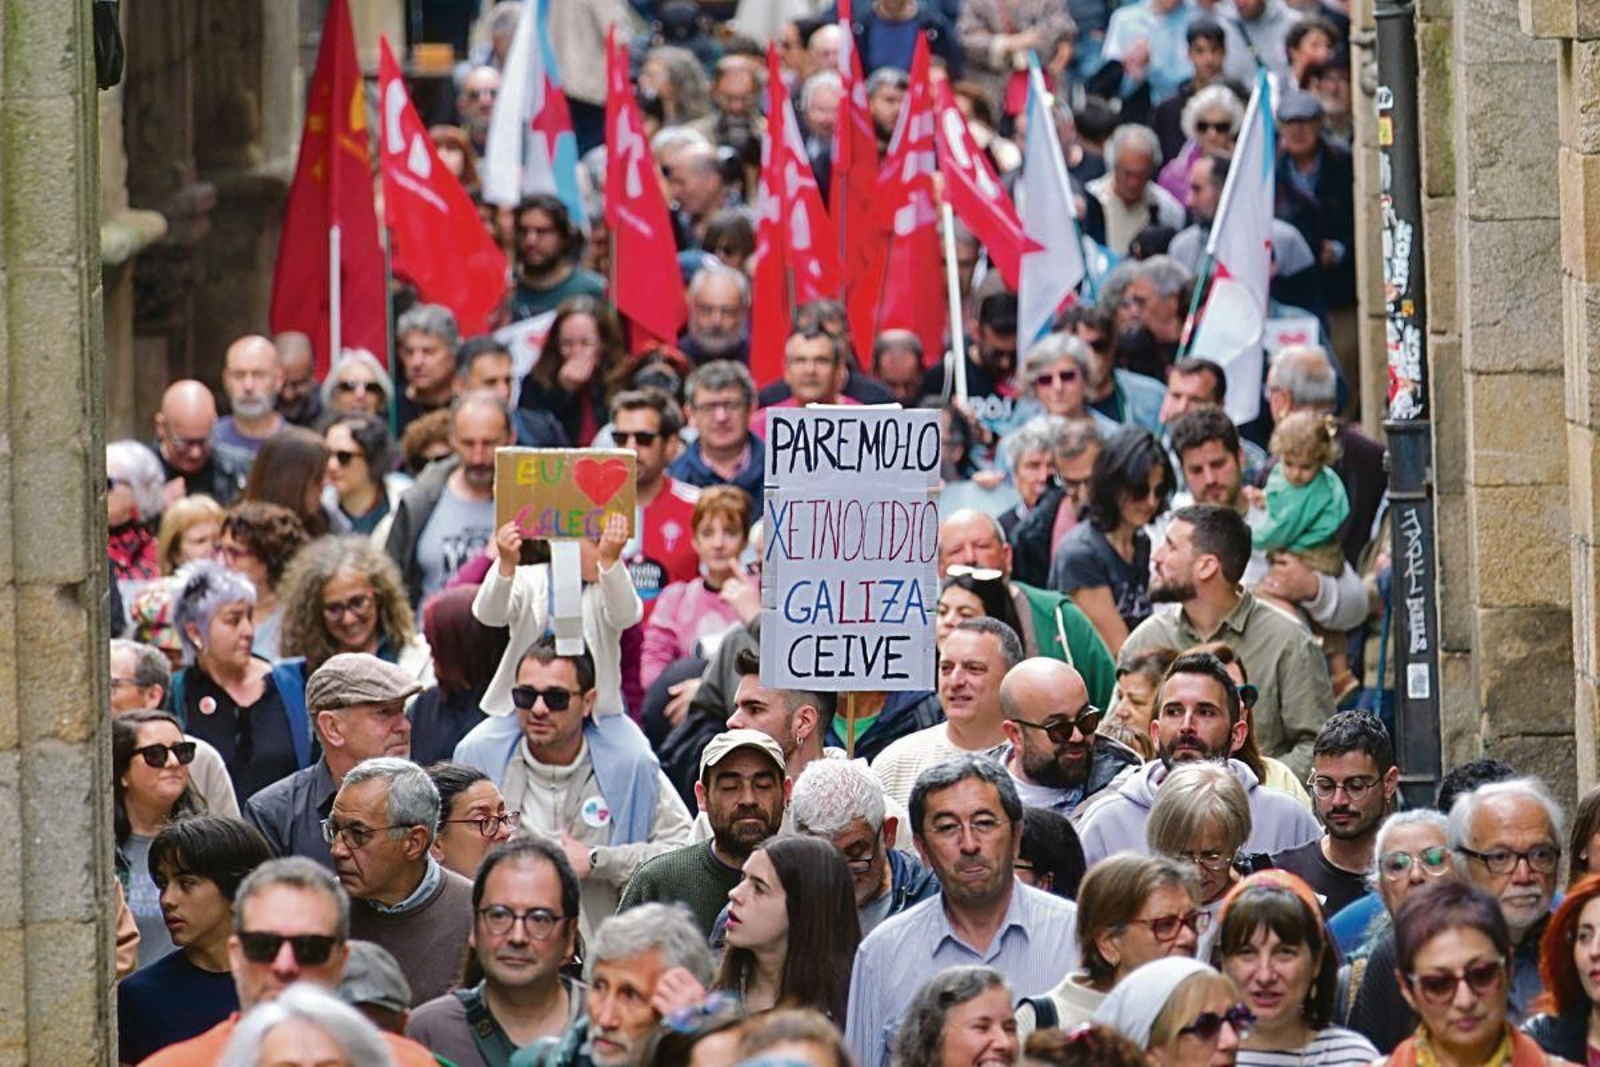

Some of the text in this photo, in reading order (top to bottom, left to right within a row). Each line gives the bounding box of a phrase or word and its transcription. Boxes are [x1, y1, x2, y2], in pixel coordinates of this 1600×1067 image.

[515, 455, 564, 487] EU
[784, 578, 928, 626] GALIZA
[787, 634, 911, 680] CEIVE
